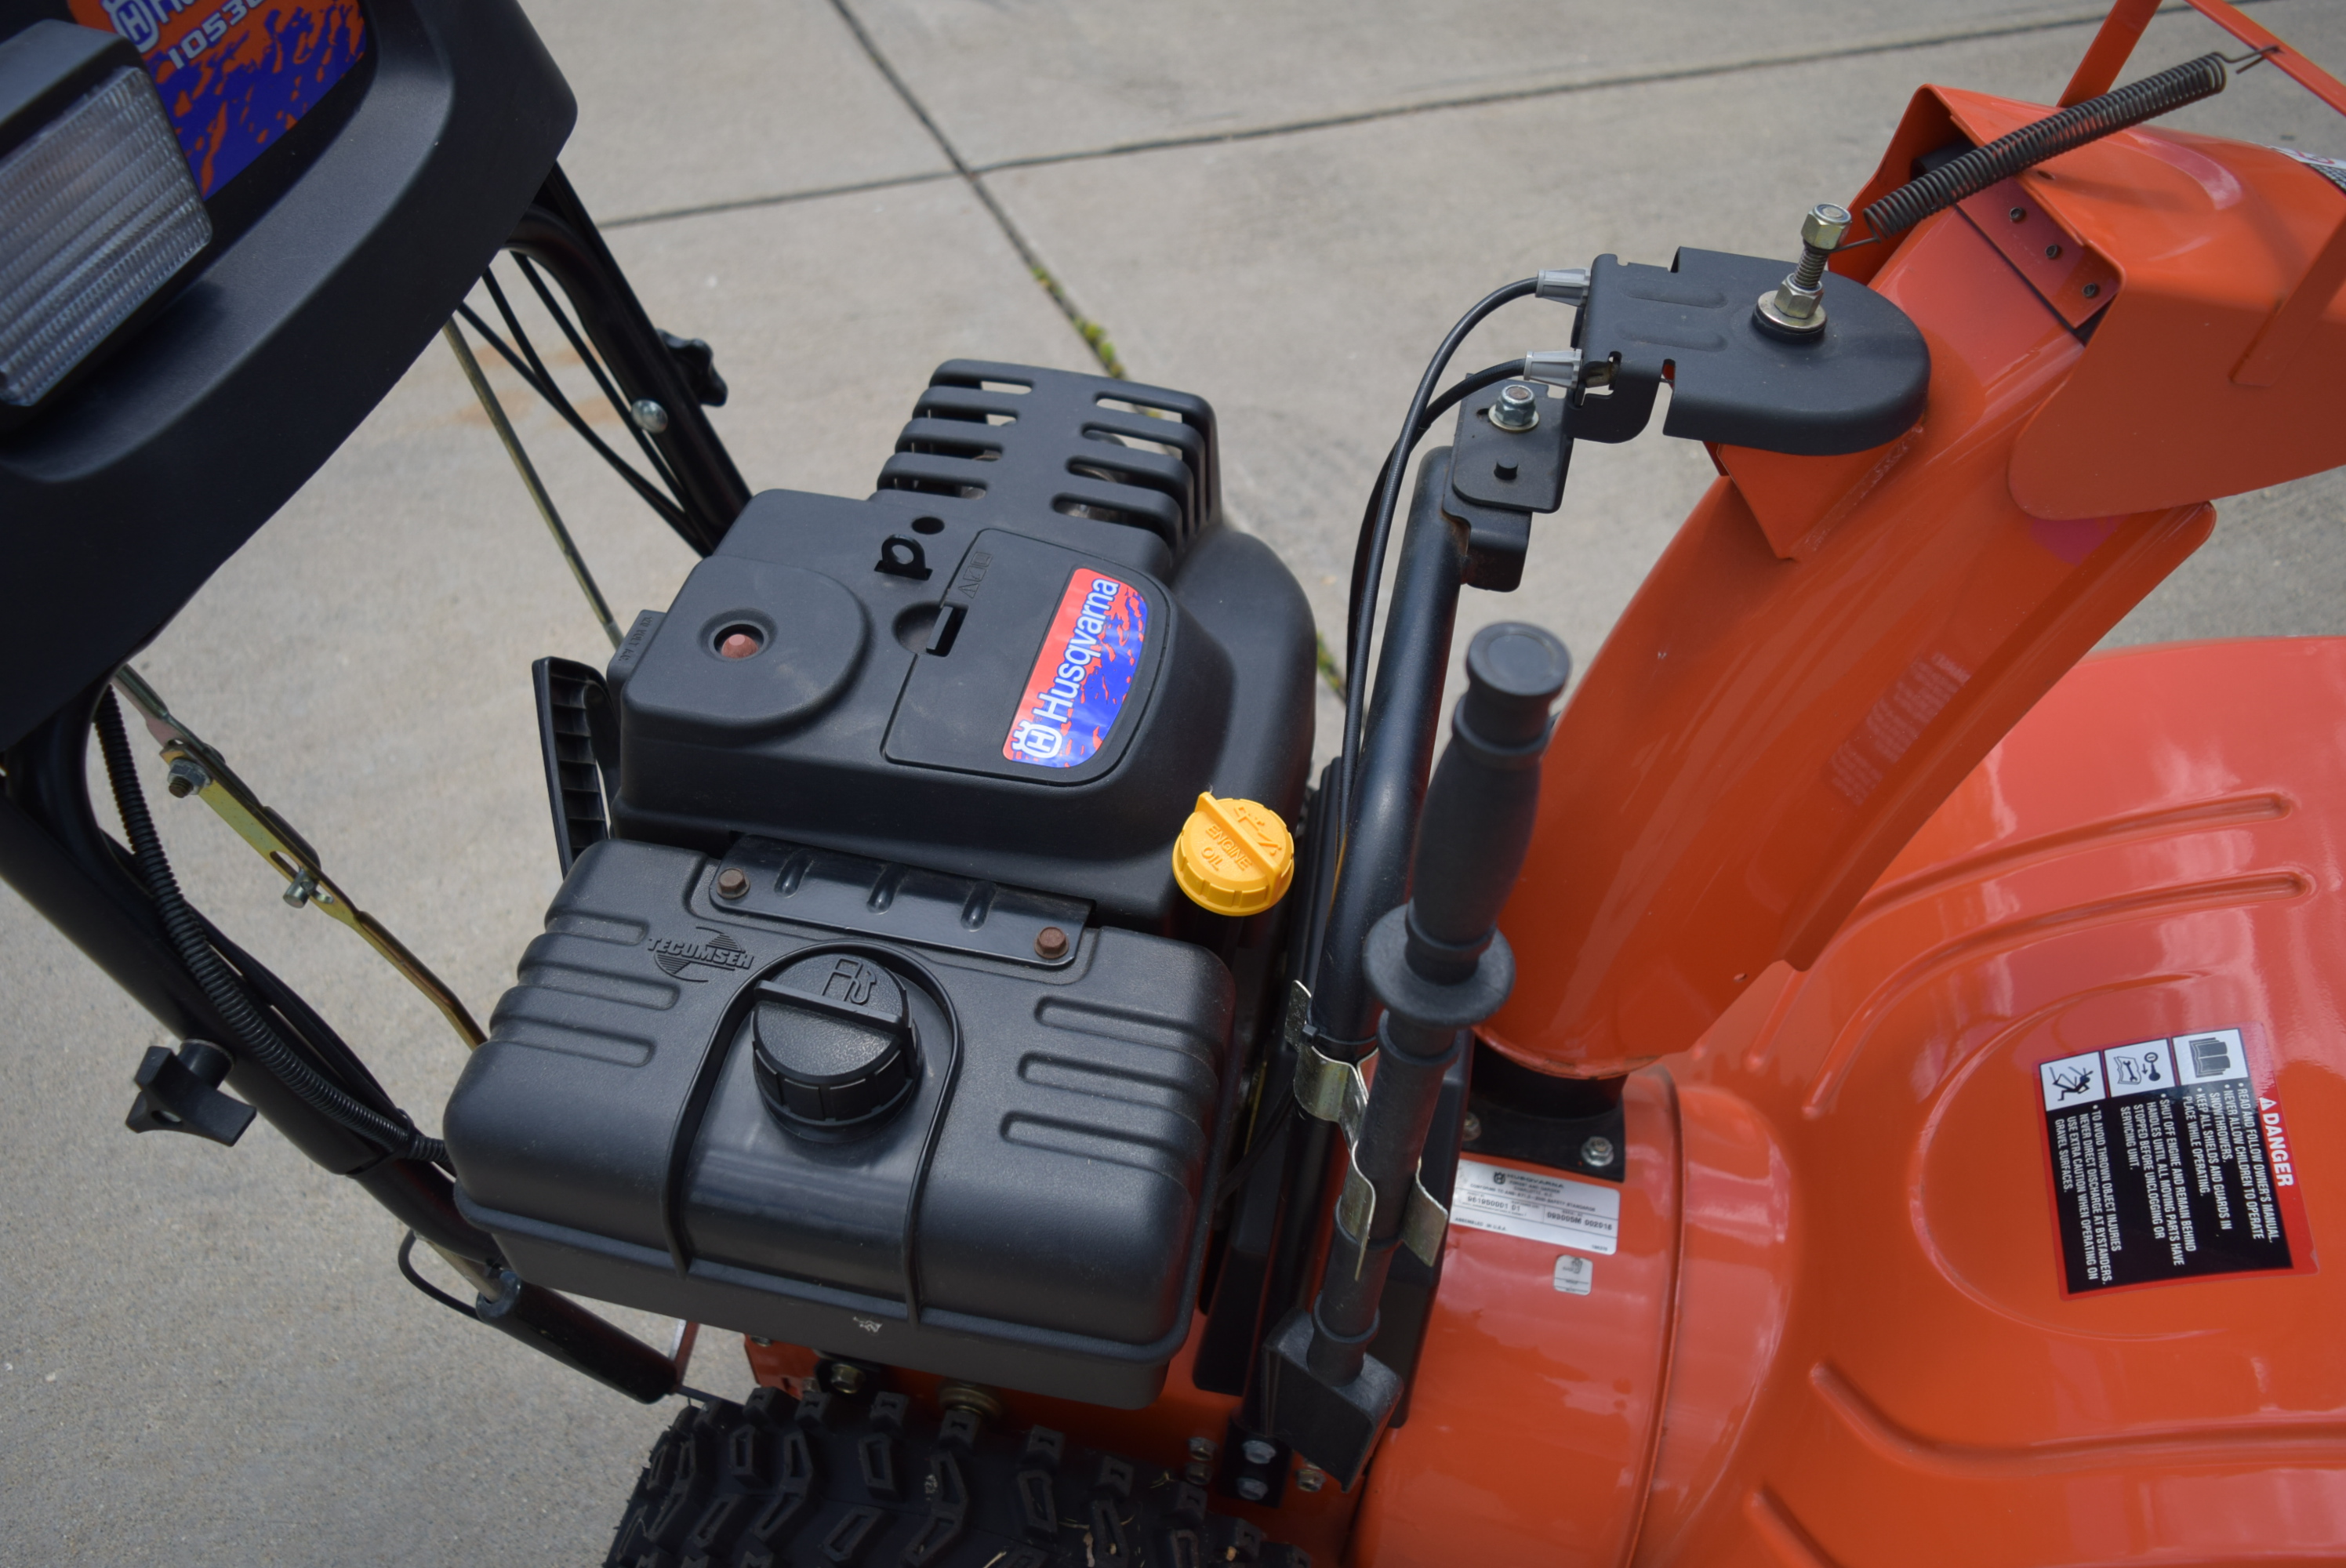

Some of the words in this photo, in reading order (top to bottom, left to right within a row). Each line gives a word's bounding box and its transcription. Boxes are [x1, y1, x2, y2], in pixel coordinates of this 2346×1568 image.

[629, 630, 647, 647] VOLT
[1032, 578, 1120, 723] Husqvarna
[1201, 847, 1226, 871] OIL
[1205, 824, 1253, 871] ENGINE
[648, 938, 755, 971] TECUMSEH
[2159, 1098, 2173, 1119] SHUT
[2181, 1094, 2196, 1120] PLACE
[2195, 1092, 2209, 1112] KEEP
[2223, 1089, 2238, 1115] NEVER
[2237, 1087, 2251, 1109] READ
[2066, 1115, 2078, 1131] USE
[2079, 1112, 2092, 1138] NEVER
[2091, 1109, 2102, 1121] TO
[2119, 1105, 2137, 1147] SERVICING
[2133, 1103, 2148, 1139] STOPPED
[2146, 1101, 2162, 1138] HANDLES
[2163, 1120, 2176, 1136] OFF
[2199, 1113, 2212, 1129] ALL
[2206, 1091, 2233, 1162] SNOWTHROWERS.
[2241, 1110, 2255, 1127] AND
[2054, 1118, 2067, 1149] GRAVEL
[2068, 1131, 2081, 1158] EXTRA
[2093, 1122, 2105, 1145] AVOID
[2187, 1120, 2202, 1146] WHILE
[2228, 1116, 2244, 1144] ALLOW
[2082, 1138, 2096, 1167] DIRECT
[2126, 1147, 2140, 1170] UNIT.
[2138, 1139, 2154, 1171] BEFORE
[2152, 1138, 2166, 1162] UNTIL
[2166, 1137, 2181, 1167] ENGINE
[2202, 1129, 2219, 1163] SHIELDS
[2245, 1128, 2263, 1162] FOLLOW
[2262, 1112, 2293, 1186] DANGER
[2058, 1149, 2073, 1192] SURFACES.
[2072, 1157, 2086, 1192] CAUTION
[2097, 1145, 2111, 1181] THROWN
[2156, 1163, 2169, 1178] ALL
[2171, 1167, 2184, 1185] AND
[2192, 1147, 2210, 1196] OPERATING.
[2209, 1165, 2223, 1182] AND
[2234, 1145, 2253, 1186] CHILDREN
[2086, 1167, 2102, 1214] DISCHARGE
[2101, 1182, 2115, 1211] OBJECT
[2159, 1179, 2175, 1213] MOVING
[2243, 1187, 2256, 1200] TO
[2253, 1163, 2272, 1202] OWNER'S
[2077, 1192, 2090, 1218] WHEN
[2144, 1171, 2163, 1225] UNCLOGGING
[2174, 1185, 2190, 1218] REMAIN
[2212, 1183, 2230, 1218] GUARDS
[2093, 1214, 2104, 1225] AT
[2106, 1213, 2122, 1251] INJURIES
[2152, 1225, 2166, 1239] OR
[2165, 1213, 2181, 1242] PARTS
[2220, 1219, 2232, 1229] IN
[2245, 1200, 2264, 1239] OPERATE
[2261, 1203, 2279, 1243] MANUAL.
[2080, 1218, 2097, 1265] OPERATING
[2180, 1219, 2196, 1251] BEHIND
[2094, 1226, 2112, 1284] BYSTANDERS.
[2170, 1242, 2184, 1265] HAVE
[2086, 1266, 2098, 1279] ON
